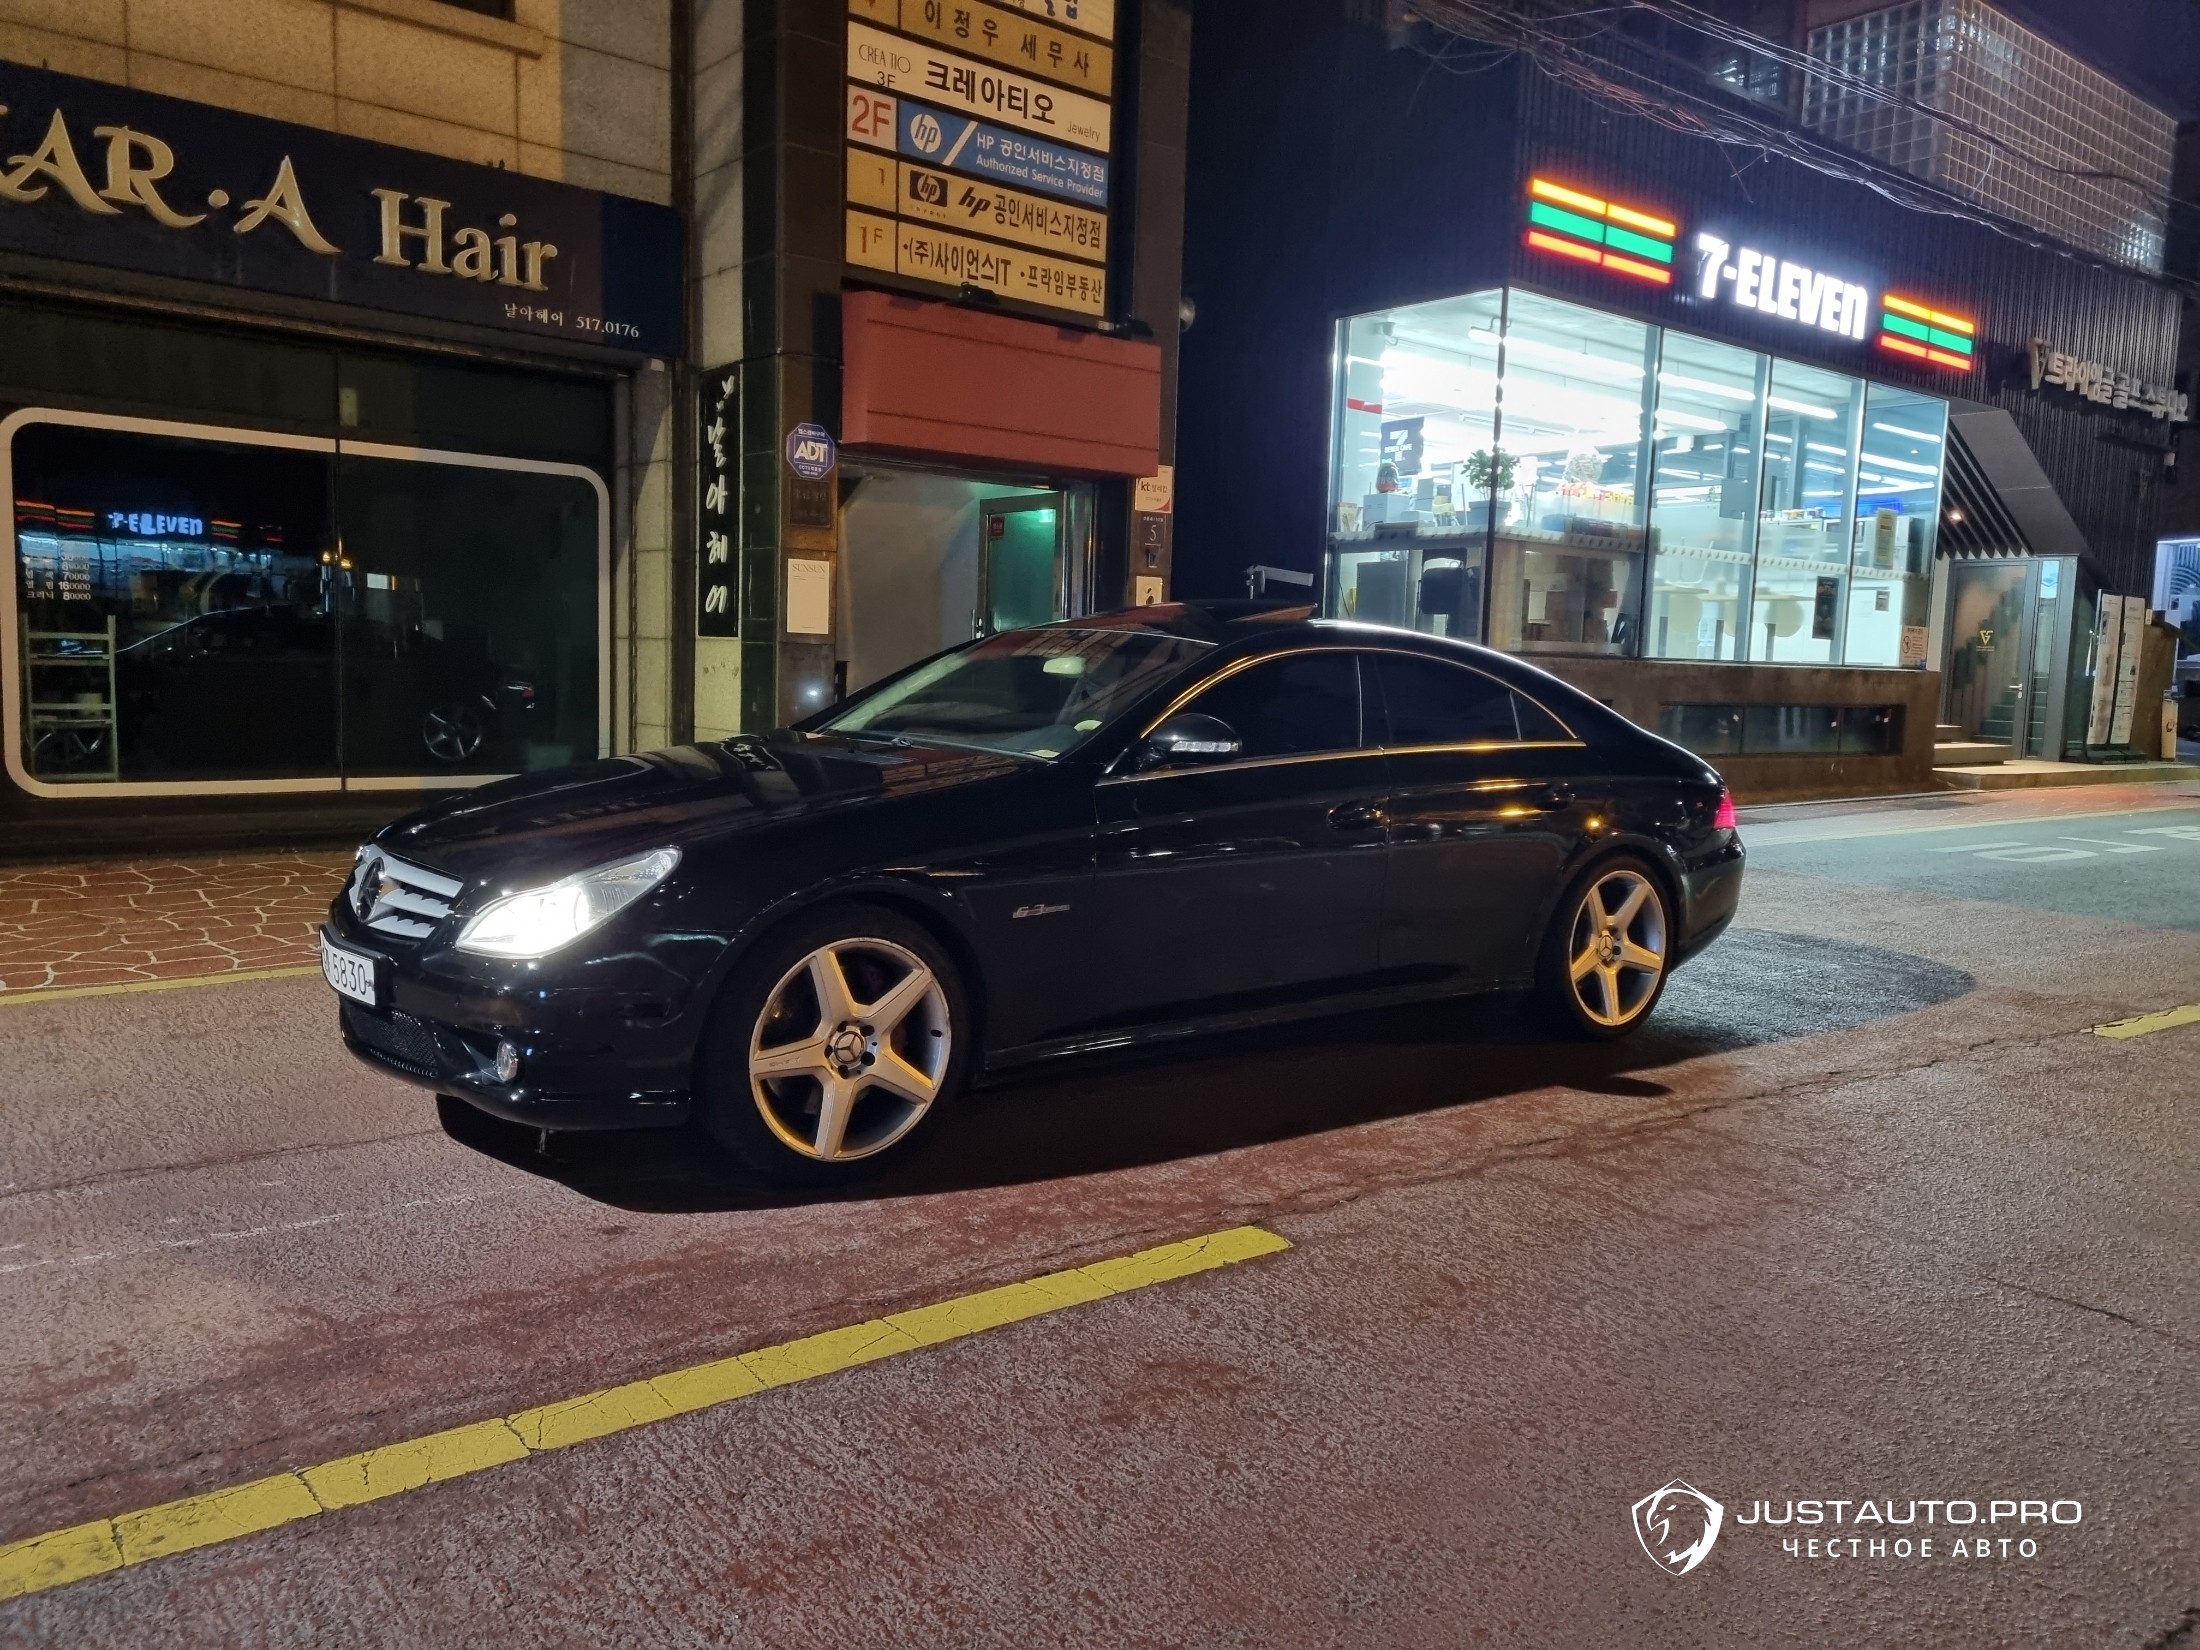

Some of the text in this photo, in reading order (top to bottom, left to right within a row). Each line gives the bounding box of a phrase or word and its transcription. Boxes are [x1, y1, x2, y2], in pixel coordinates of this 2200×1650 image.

[925, 0, 998, 47] 이정우
[1021, 33, 1089, 78] 세무사
[877, 71, 895, 88] 3F
[925, 60, 1056, 125] 크레아티오
[851, 95, 892, 137] 2F
[914, 114, 938, 151] hp
[1066, 121, 1100, 142] Jewelry
[976, 132, 1104, 183] HP 공인서비스지정점
[976, 154, 1103, 199] Authorized Service Provider
[958, 186, 1101, 249] hp 공인서비스지정점
[371, 187, 558, 291] Hair
[575, 316, 640, 338] 517.0176
[794, 440, 828, 463] ADT
[1141, 480, 1150, 492] kt
[58, 581, 91, 590] 160000
[63, 591, 91, 601] 80000
